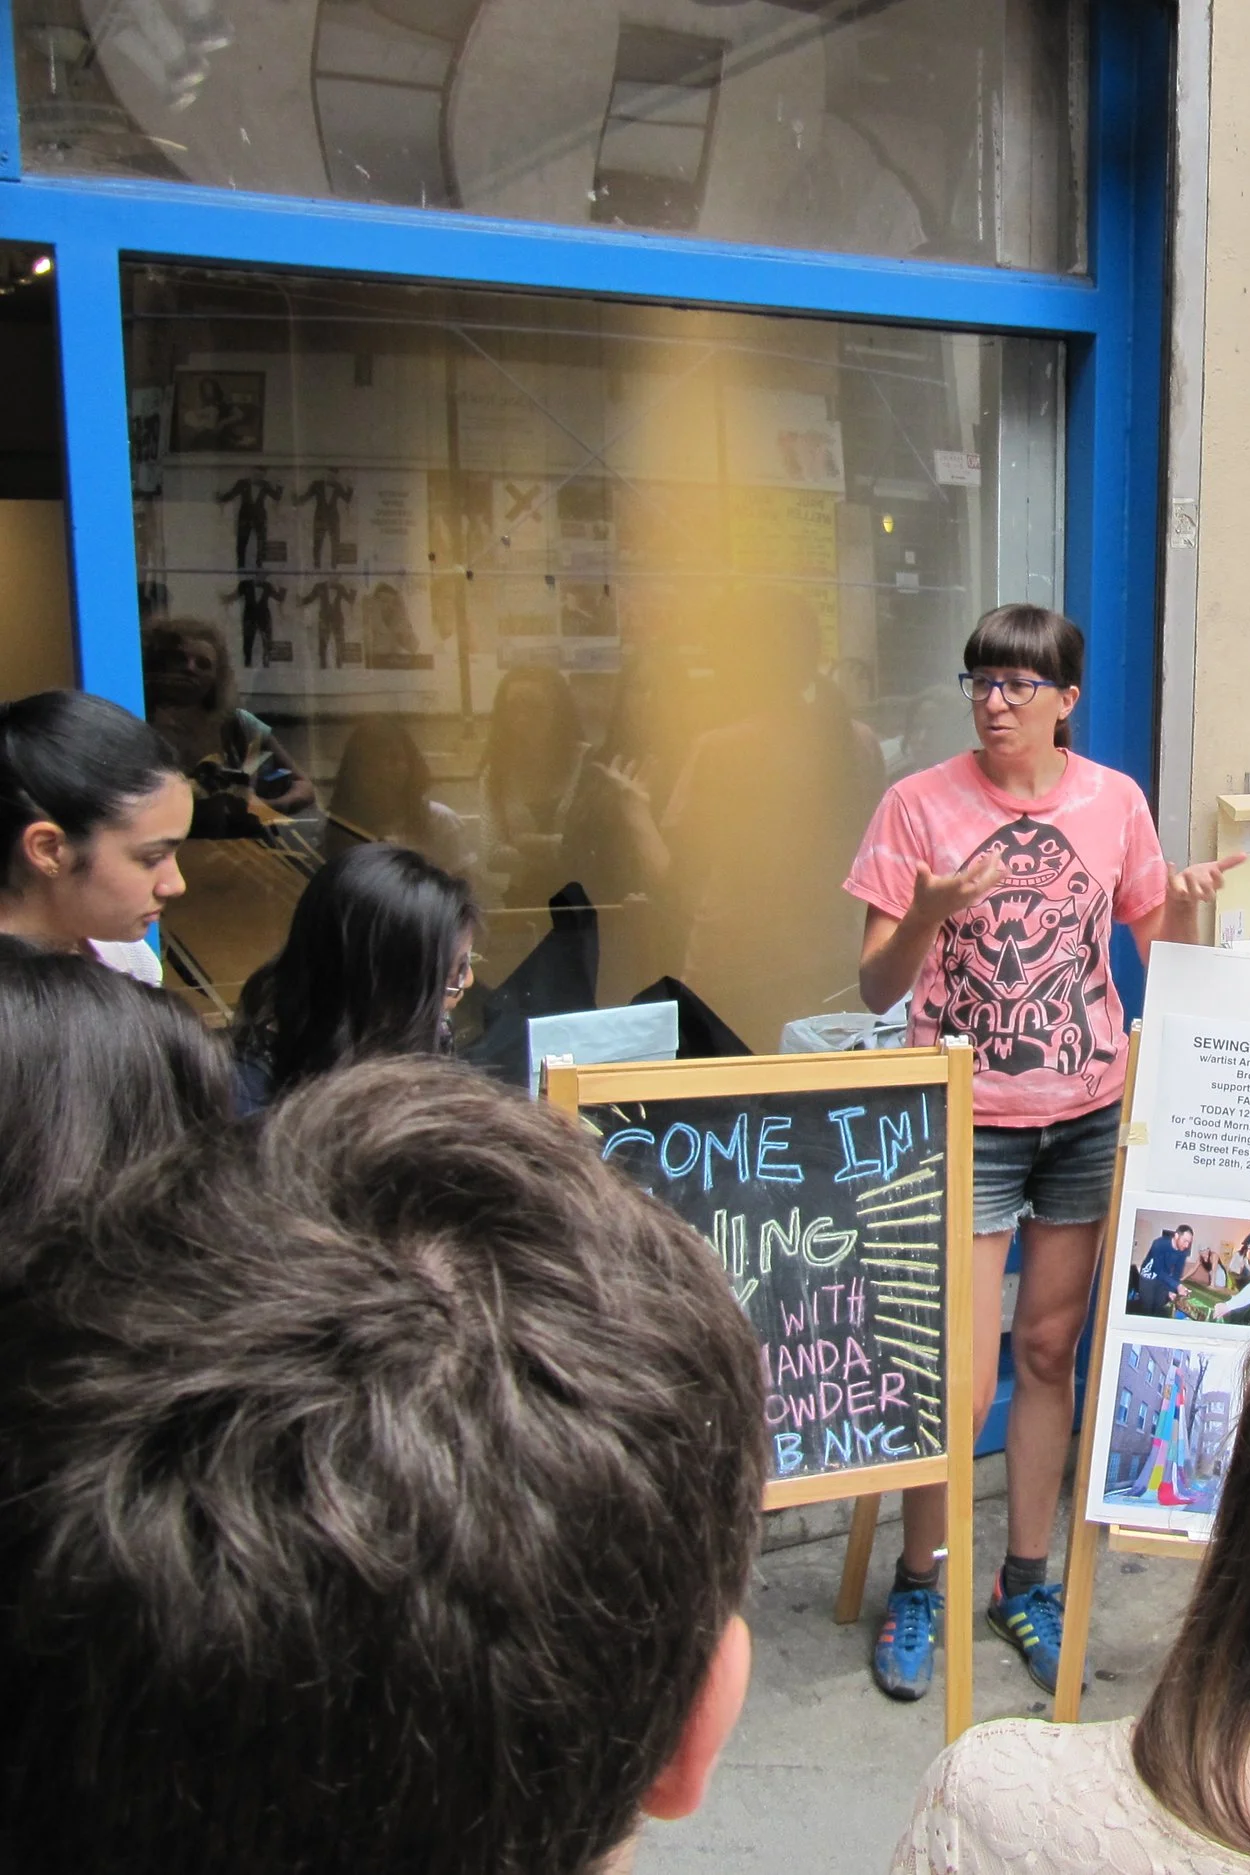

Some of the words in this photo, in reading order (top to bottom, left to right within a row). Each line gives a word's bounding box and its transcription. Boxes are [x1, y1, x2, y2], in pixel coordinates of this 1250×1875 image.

[1193, 1036, 1250, 1053] SEWING
[1199, 1054, 1237, 1066] w/artist
[1200, 1104, 1236, 1116] TODAY
[1171, 1115, 1186, 1124] for
[1189, 1116, 1221, 1128] "Good
[1184, 1129, 1218, 1140] shown
[1175, 1140, 1196, 1151] FAB
[1199, 1143, 1229, 1154] Street
[1193, 1155, 1216, 1167] Sept
[1219, 1157, 1243, 1169] 28th,
[780, 1276, 866, 1337] WITH
[761, 1336, 872, 1387] ANDA
[764, 1372, 911, 1430] OWDER
[824, 1420, 913, 1467] NYC
